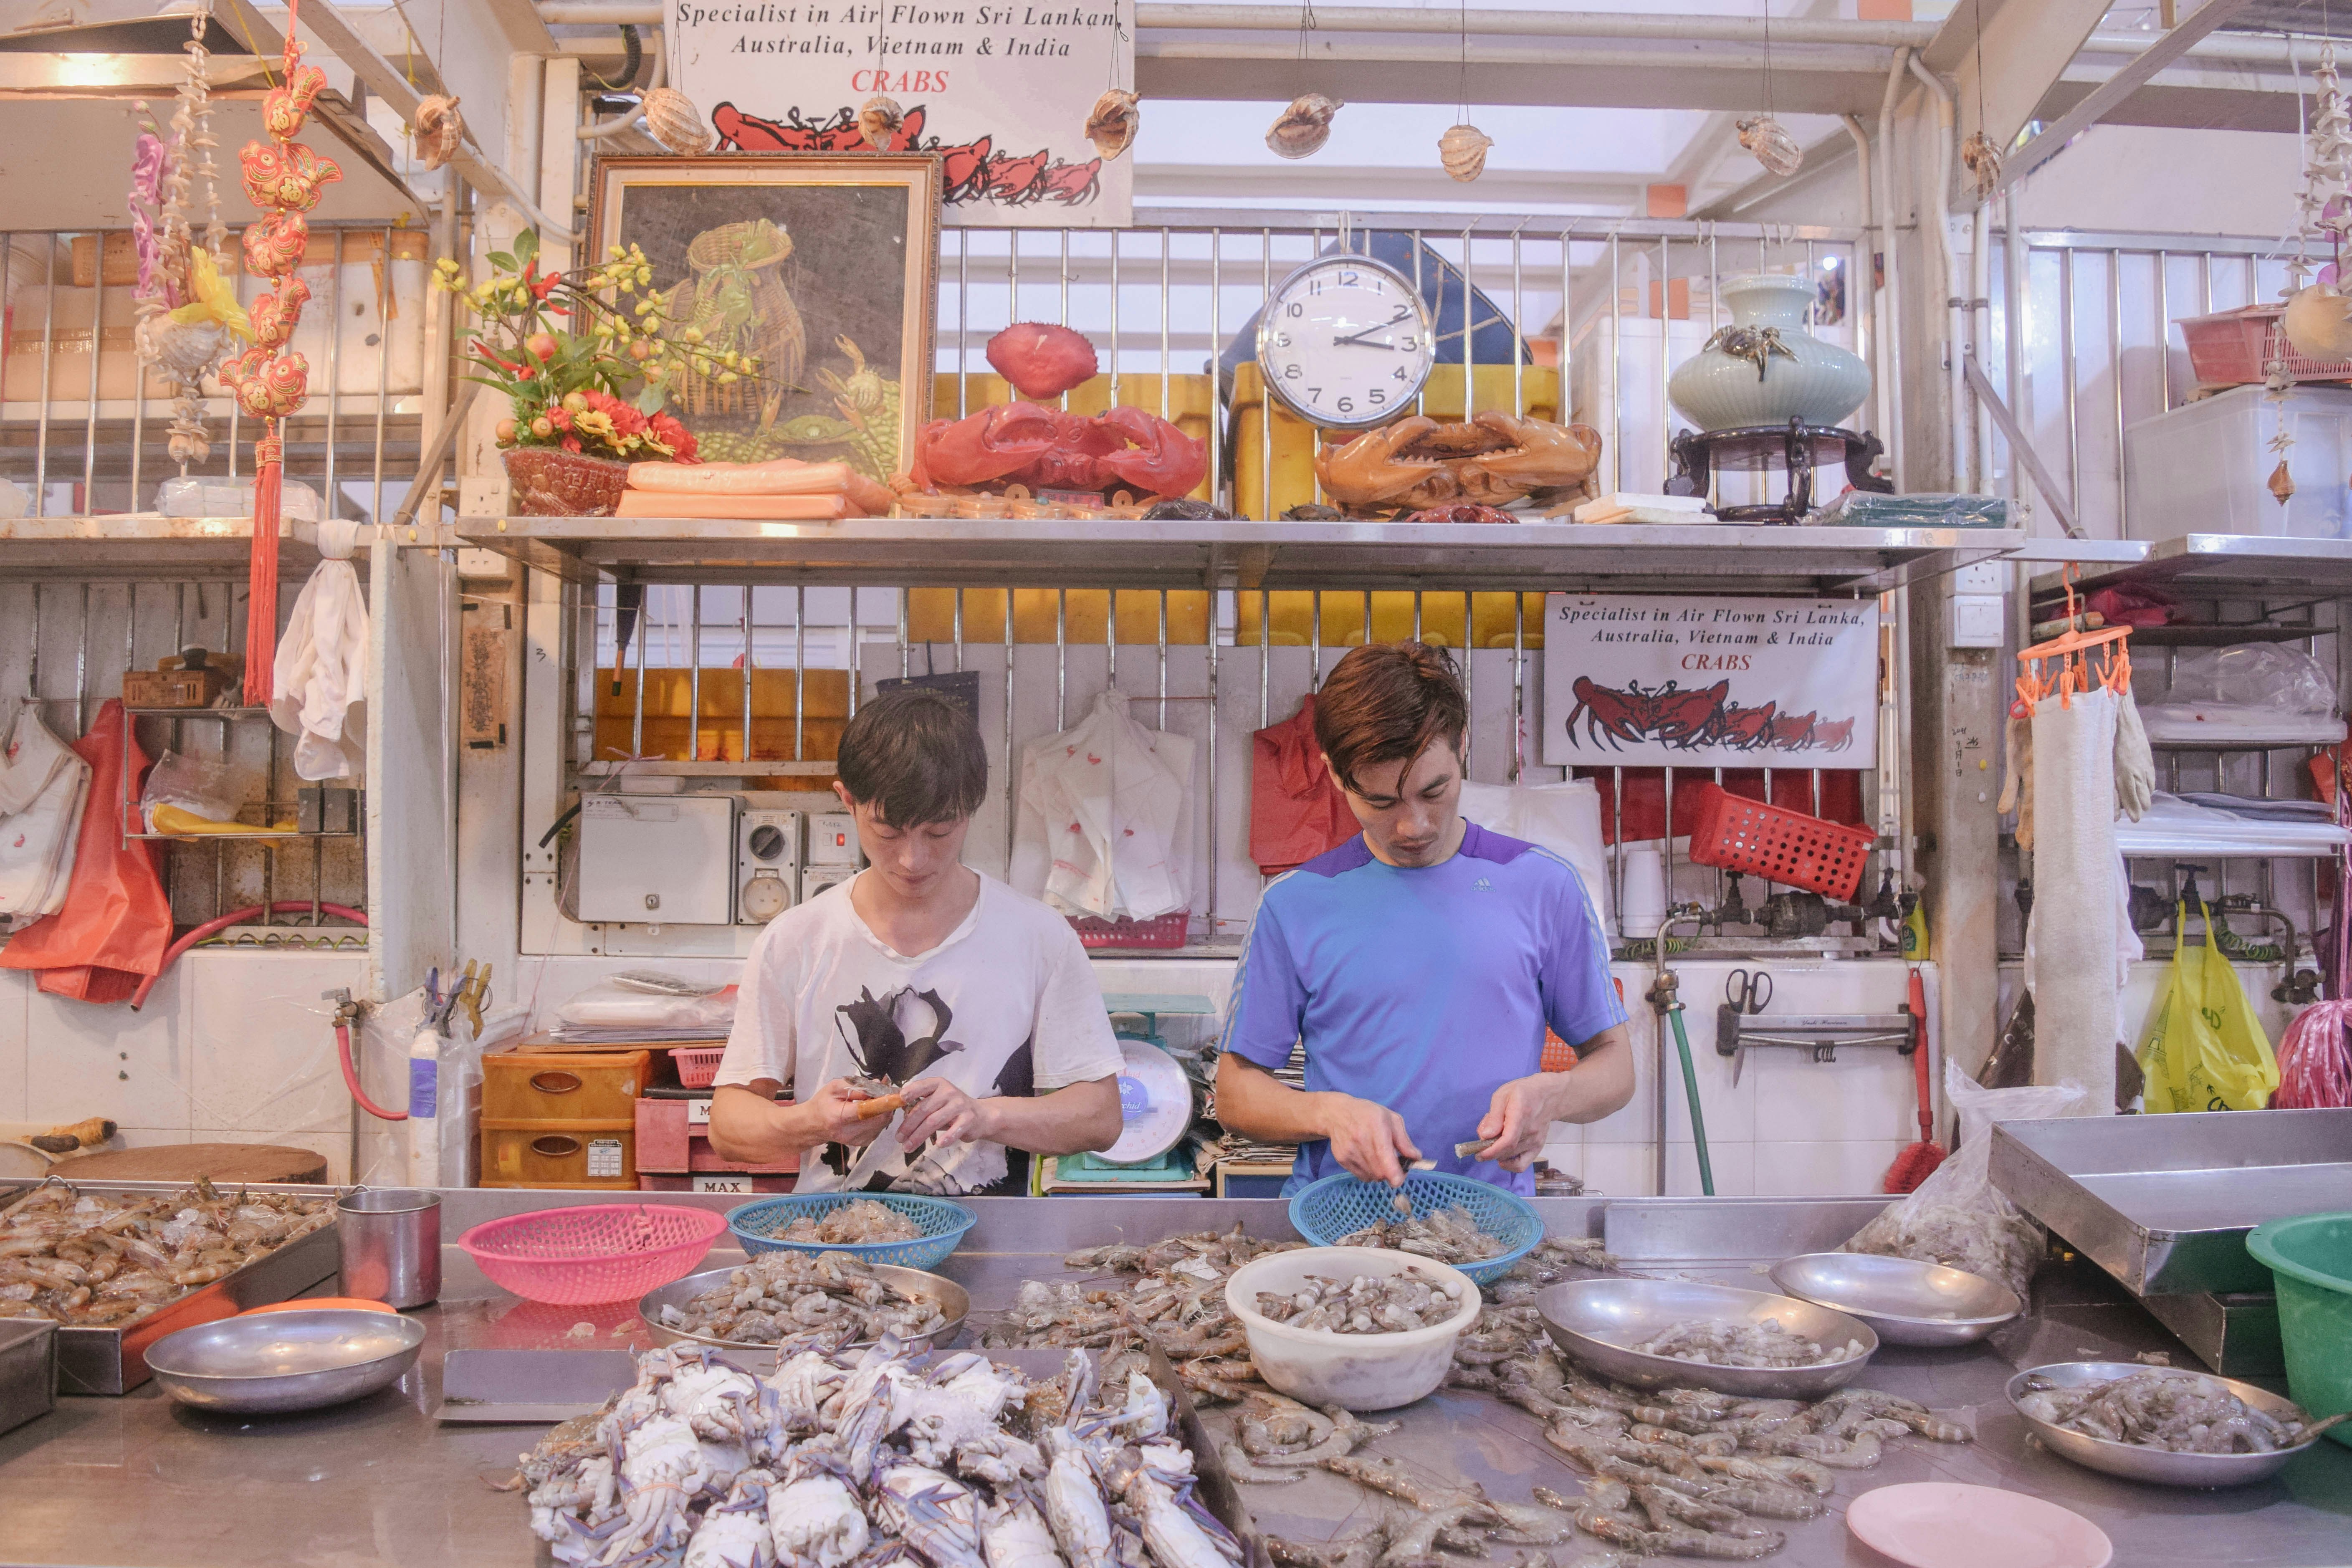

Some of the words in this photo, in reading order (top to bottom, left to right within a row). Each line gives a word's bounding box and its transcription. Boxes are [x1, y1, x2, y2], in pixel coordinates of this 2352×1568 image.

[678, 3, 796, 27] Specialist
[807, 4, 829, 23] in
[839, 5, 878, 23] Air
[891, 5, 964, 24] Flown
[976, 6, 1012, 25] Sri
[731, 35, 852, 57] Australia,
[867, 36, 963, 55] Vietnam
[976, 37, 993, 55] &
[1006, 38, 1070, 56] India
[852, 69, 949, 92] CRABS
[1339, 271, 1358, 286] 12
[1310, 281, 1321, 295] 11
[1378, 281, 1381, 295] 1
[1287, 303, 1302, 318] 10
[1393, 304, 1409, 320] 2
[1401, 336, 1418, 352] 3
[1285, 364, 1302, 379] 8
[1392, 366, 1407, 381] 4
[1308, 388, 1322, 403] 7
[1369, 389, 1386, 404] 5
[1337, 397, 1354, 412] 6
[1560, 607, 1646, 624] Specialist
[1653, 608, 1669, 621] in
[1677, 608, 1705, 622] Air
[1713, 609, 1765, 623] Flown
[1773, 610, 1799, 624] Sri
[1806, 611, 1864, 626] Lanka,
[1591, 629, 1679, 645] Australia,
[1690, 630, 1758, 644] Vietnam
[1767, 631, 1778, 644] &
[1788, 632, 1834, 645] India
[1682, 654, 1752, 670] CRABS
[705, 1182, 741, 1192] MAX
